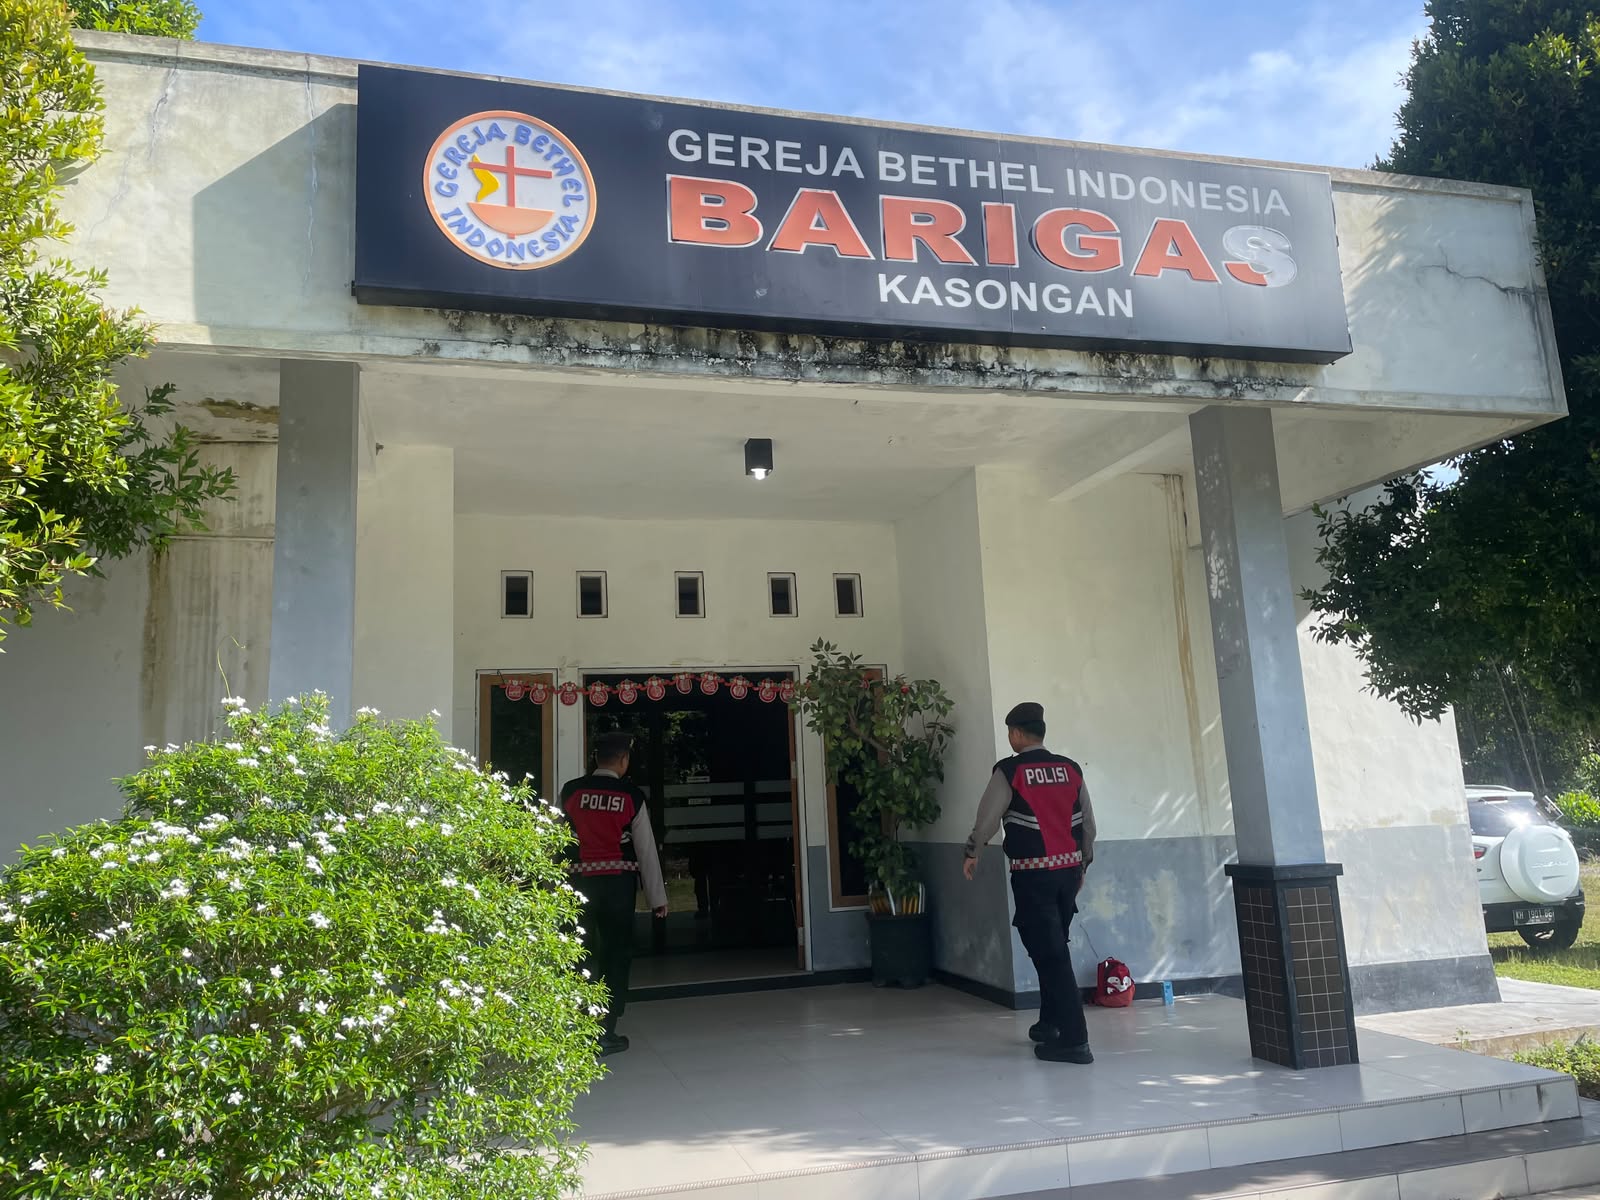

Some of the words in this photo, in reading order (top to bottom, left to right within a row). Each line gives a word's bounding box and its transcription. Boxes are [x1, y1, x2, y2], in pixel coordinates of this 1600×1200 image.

[435, 122, 508, 198] GEREJA
[514, 124, 585, 208] BETHEL
[667, 128, 865, 179] GEREJA
[878, 149, 1054, 194] BETHEL
[1066, 167, 1291, 217] INDONESIA
[440, 207, 580, 260] INDONESIA
[665, 173, 1298, 288] BARIGAS
[878, 273, 1134, 318] KASONGAN
[1025, 766, 1070, 785] POLISI
[580, 793, 625, 812] POLISI
